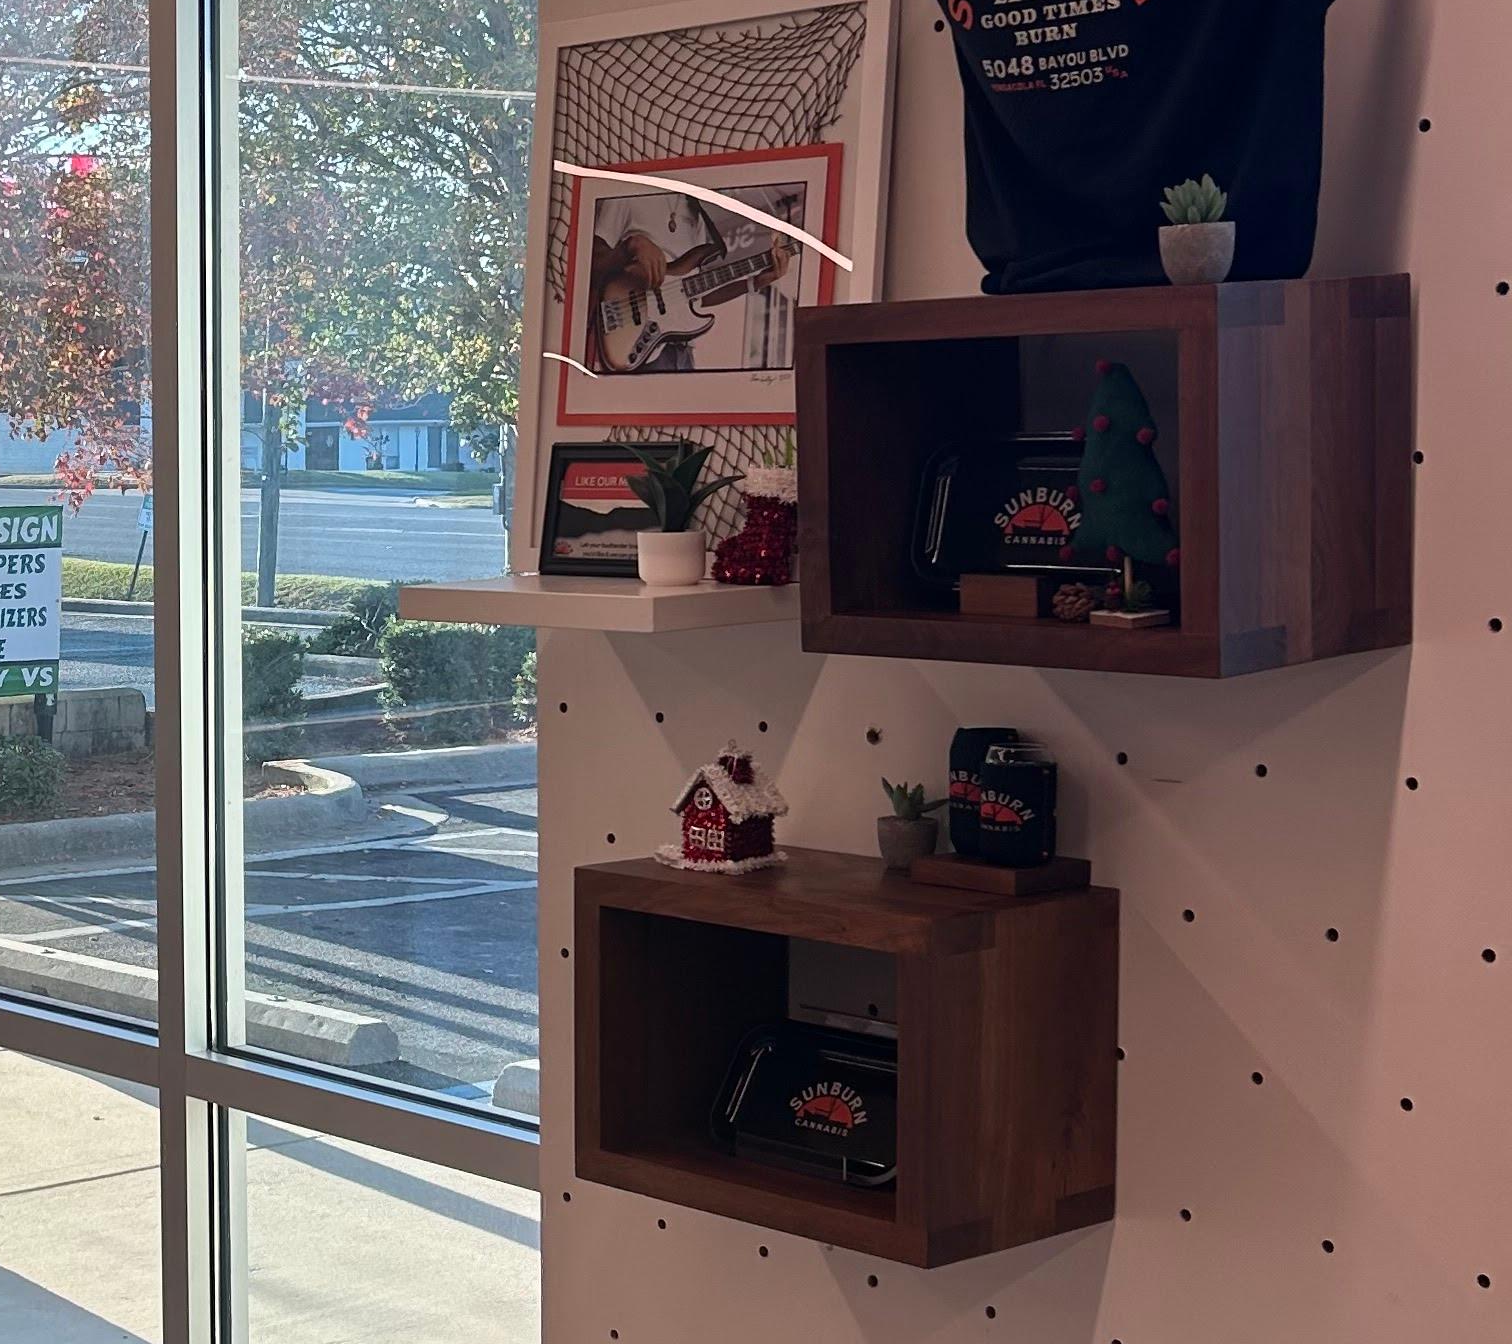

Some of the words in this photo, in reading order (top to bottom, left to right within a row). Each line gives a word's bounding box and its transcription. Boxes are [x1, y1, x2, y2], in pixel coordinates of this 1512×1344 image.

[980, 8, 1037, 29] GOOD
[1014, 22, 1078, 46] BURN
[981, 55, 1035, 79] 5048
[1038, 51, 1086, 71] BAYOU
[1089, 44, 1129, 63] BLVD
[1049, 66, 1104, 91] 32503
[575, 476, 596, 487] LIKE
[597, 476, 618, 487] OUR
[994, 486, 1082, 531] SUNBURN
[1004, 534, 1067, 547] CANNABIS
[20, 666, 54, 687] VS
[789, 1081, 869, 1126] SUNBURN
[794, 1117, 849, 1137] CANNABIS
